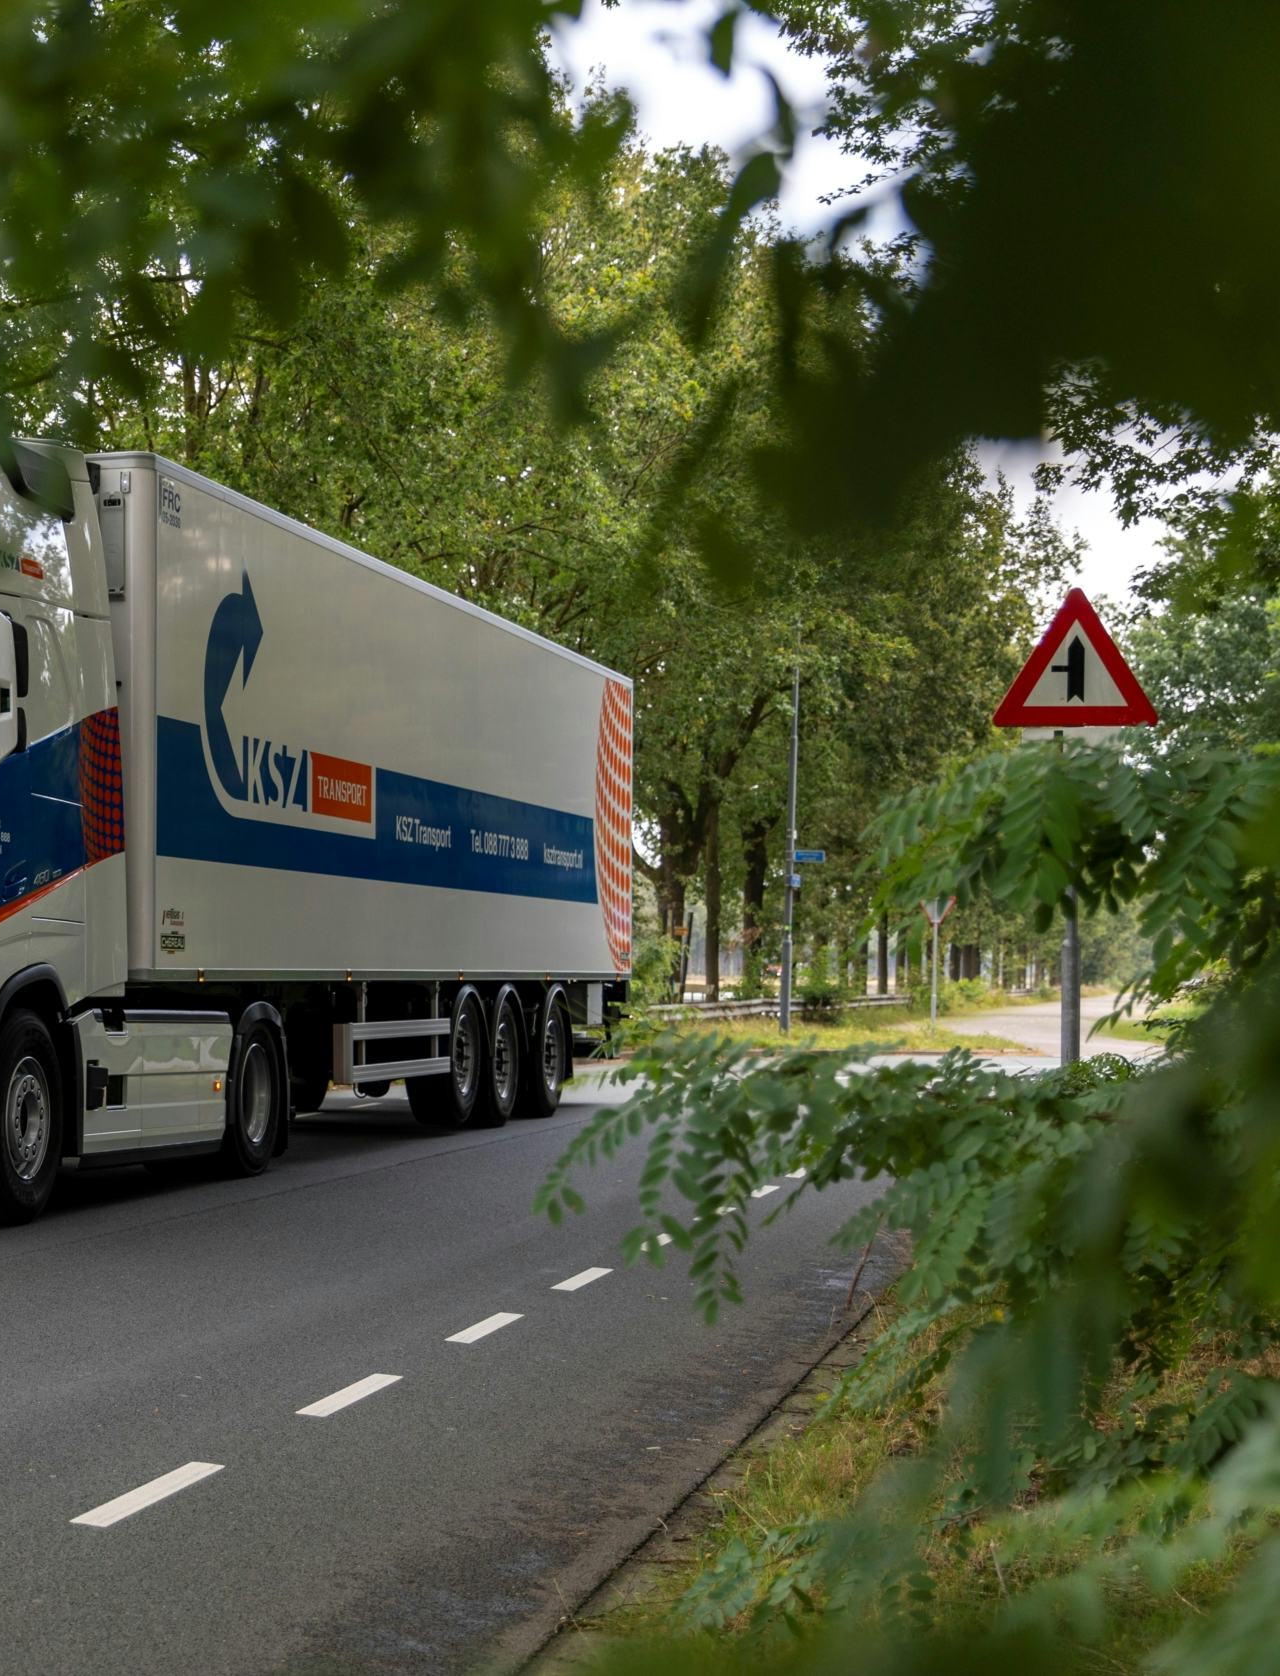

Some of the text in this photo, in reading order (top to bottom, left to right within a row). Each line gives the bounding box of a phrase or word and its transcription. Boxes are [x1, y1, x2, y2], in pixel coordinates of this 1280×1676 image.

[162, 488, 181, 513] FRC
[247, 738, 368, 811] KSZ TRANSPORT
[395, 816, 452, 851] KSZ Transport
[470, 829, 529, 861] Tel. 088 777 3 888
[543, 843, 584, 871] ksztransport.nl
